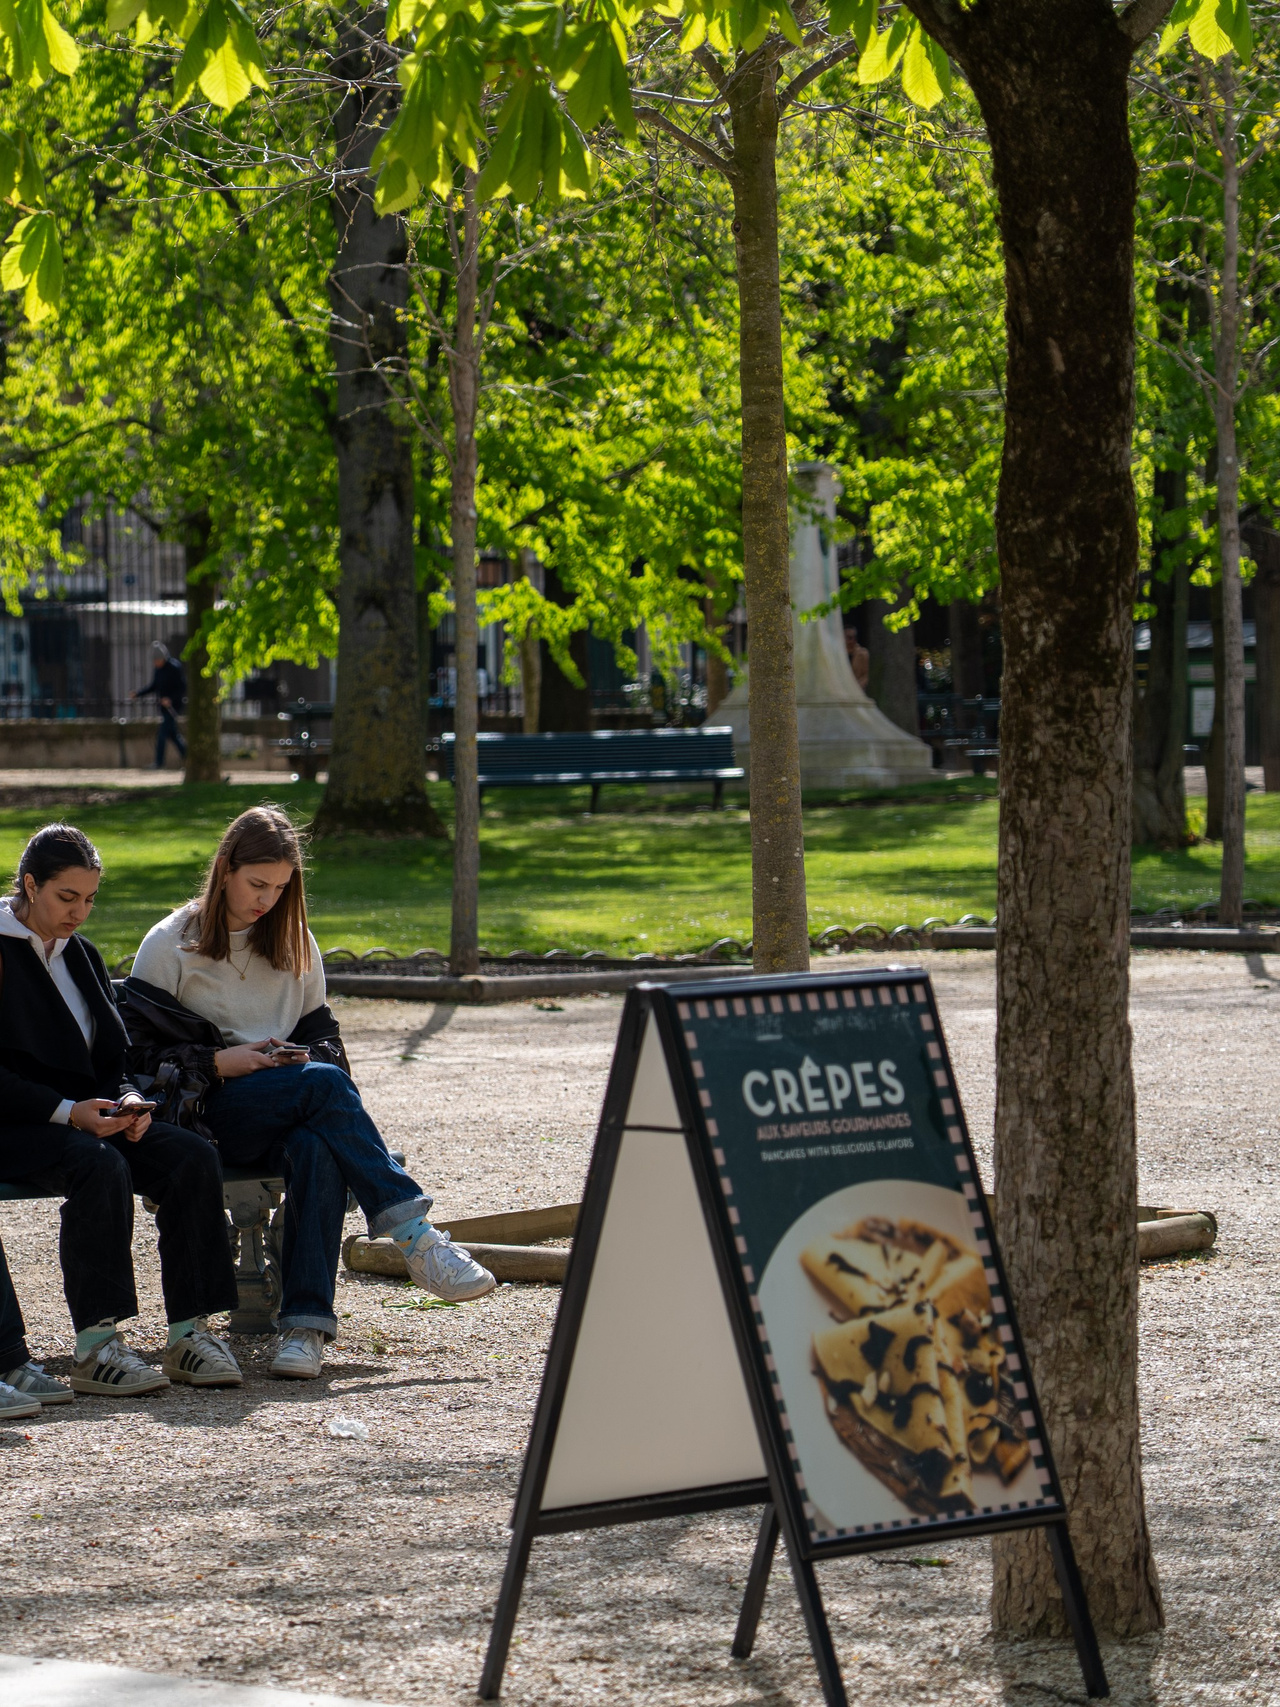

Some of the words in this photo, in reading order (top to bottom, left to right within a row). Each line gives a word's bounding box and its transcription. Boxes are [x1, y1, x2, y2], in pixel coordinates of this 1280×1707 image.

[742, 1055, 906, 1117] CRÊPES
[757, 1124, 781, 1141] AUX
[782, 1120, 831, 1139] SAVEURS
[831, 1113, 912, 1134] GOURMANDES
[761, 1148, 807, 1162] PANCAKES
[808, 1145, 830, 1158] WITH
[831, 1142, 877, 1156] DELICIOUS
[877, 1138, 915, 1152] FLAVORS
